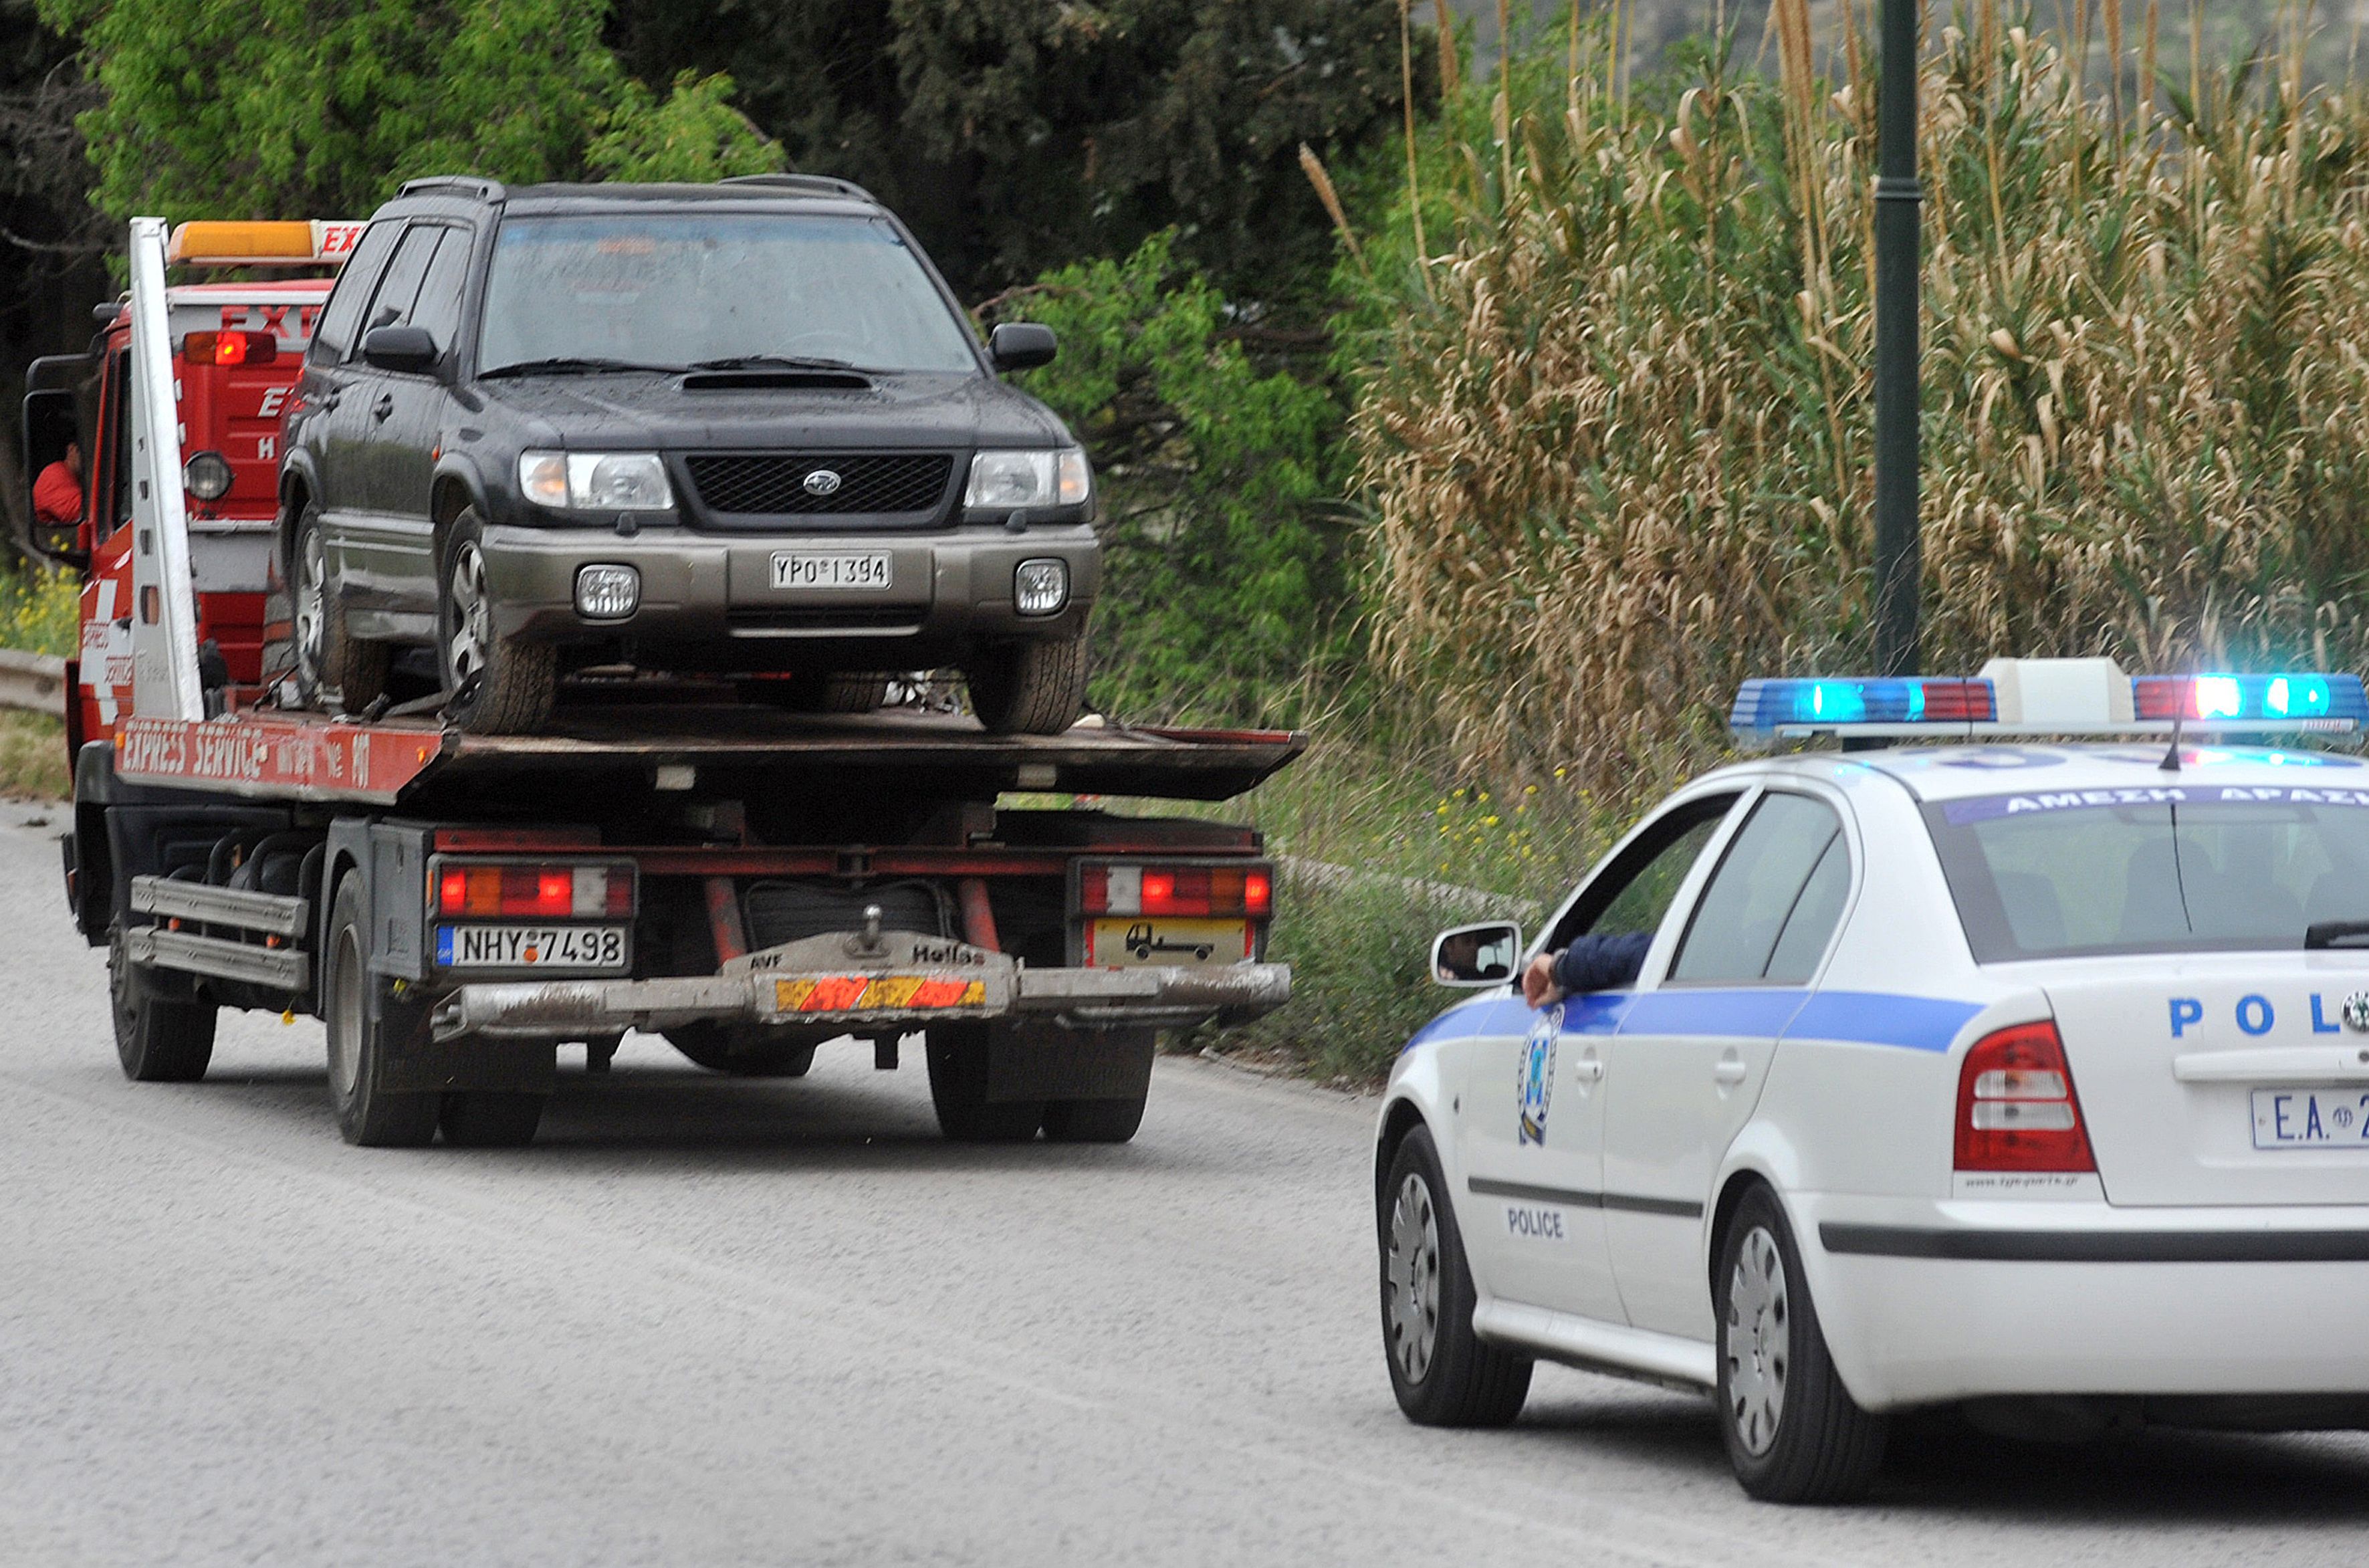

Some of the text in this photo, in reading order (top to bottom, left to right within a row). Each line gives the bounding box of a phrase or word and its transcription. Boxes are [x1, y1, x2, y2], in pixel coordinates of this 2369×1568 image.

[833, 559, 885, 583] 1394
[123, 721, 188, 773] EXPRESS
[464, 931, 620, 962] NHY 7498
[1507, 1208, 1564, 1238] POLICE
